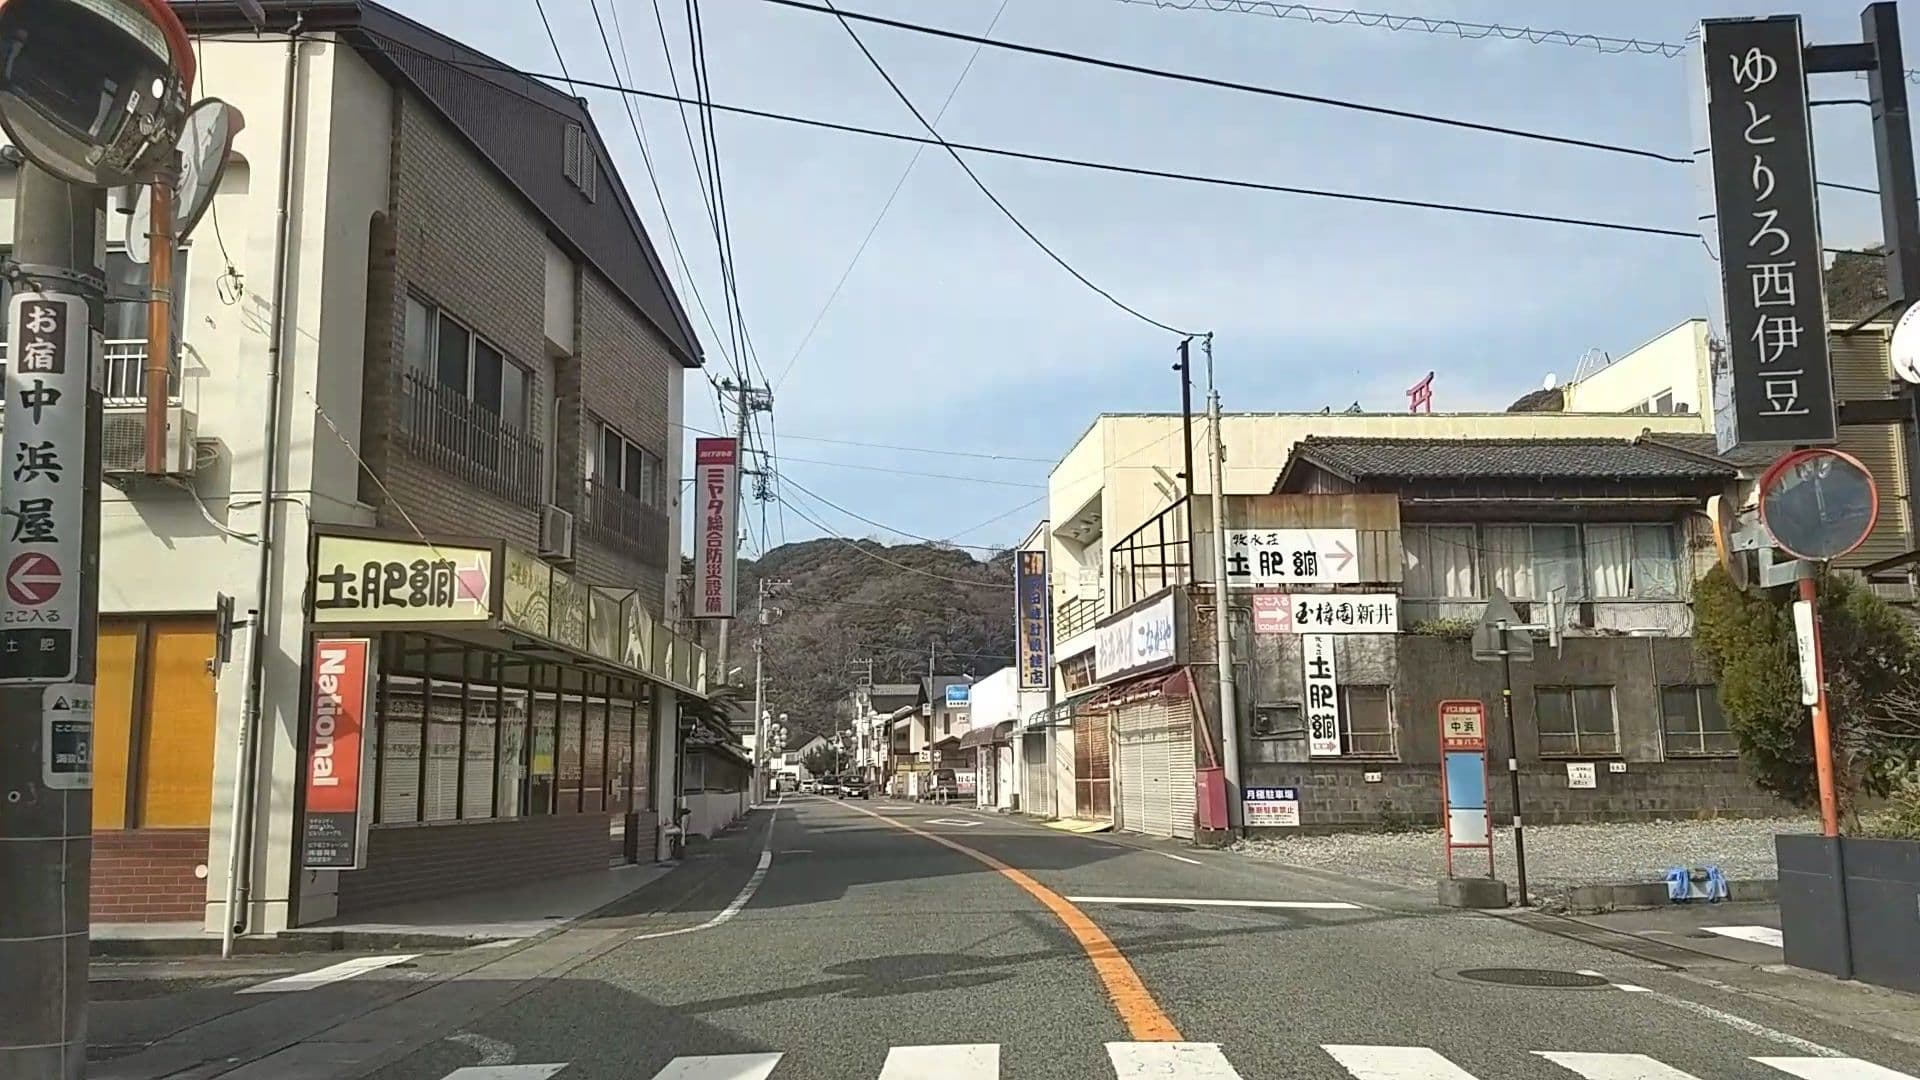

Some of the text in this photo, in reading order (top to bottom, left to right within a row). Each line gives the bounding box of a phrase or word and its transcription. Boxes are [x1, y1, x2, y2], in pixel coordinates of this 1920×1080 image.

[1729, 46, 1810, 416] ゆとりろ西伊豆
[23, 305, 57, 370] お宿
[11, 379, 63, 543] 中浜屋
[705, 468, 725, 613] ミヤタ総合防災設備
[4, 609, 60, 623] ここ入る
[1255, 597, 1289, 606] ここ入る
[6, 638, 56, 653] 土肥
[312, 649, 347, 787] National
[1450, 721, 1474, 732] 中浜
